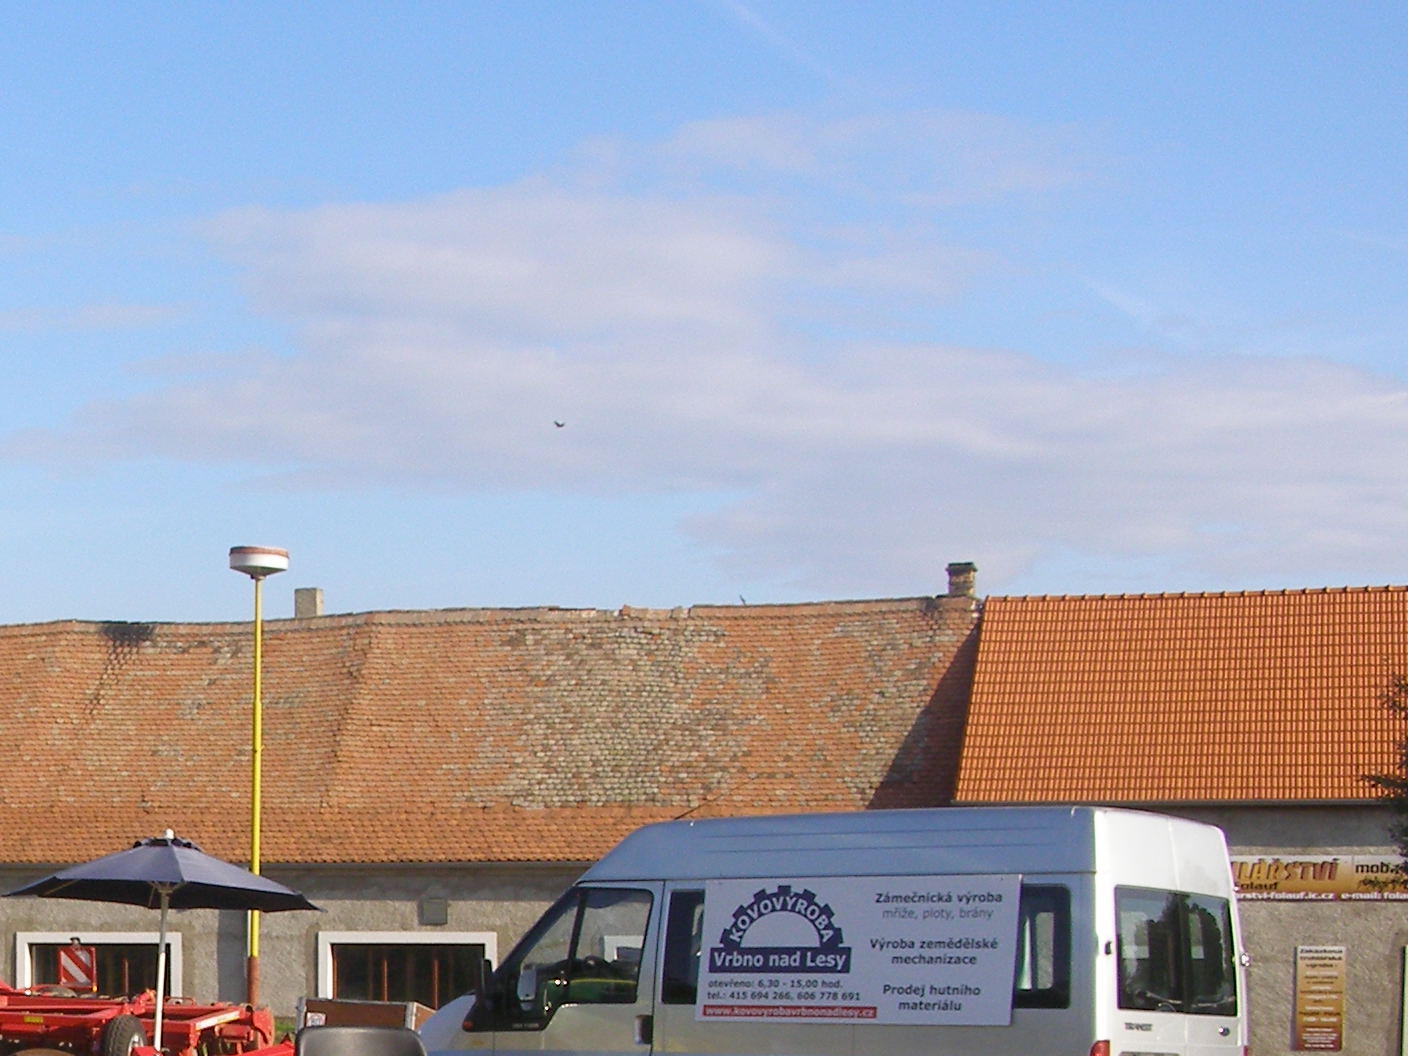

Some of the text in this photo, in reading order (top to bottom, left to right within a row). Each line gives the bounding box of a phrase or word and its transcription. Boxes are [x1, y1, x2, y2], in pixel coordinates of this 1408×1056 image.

[875, 890, 1003, 904] Zámečnická výroba
[870, 938, 999, 951] Výroba zemědělské
[713, 951, 847, 970] Vrbno nad Lesy
[891, 954, 978, 965] mechanizace
[882, 984, 981, 997] Prodej hutního
[898, 1000, 962, 1011] materiálu
